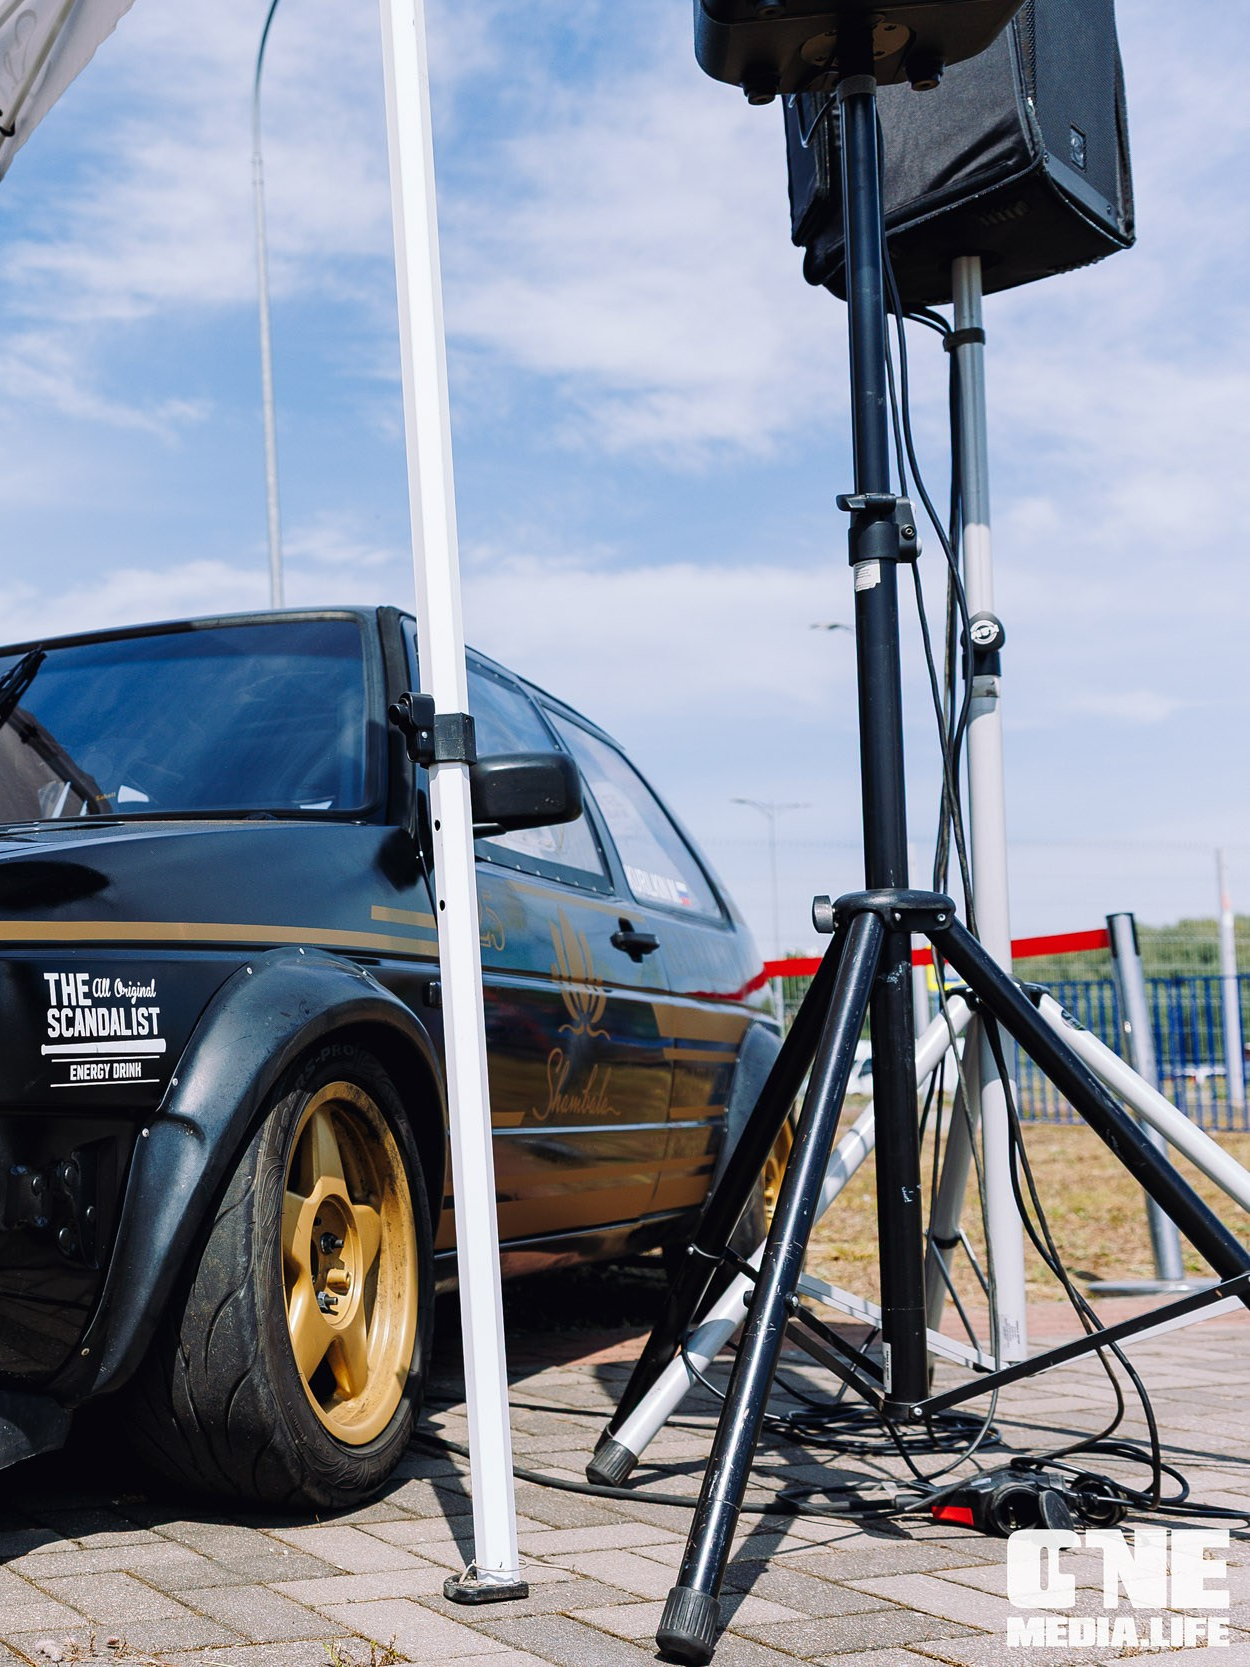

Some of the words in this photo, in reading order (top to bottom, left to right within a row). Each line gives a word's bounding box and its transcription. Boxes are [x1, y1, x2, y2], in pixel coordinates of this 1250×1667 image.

[43, 972, 93, 1006] THE
[92, 977, 111, 998] All
[114, 978, 157, 1005] Original
[46, 1007, 161, 1038] SCANDALIST
[69, 1063, 111, 1081] ENERGY
[112, 1062, 142, 1079] DRINK
[533, 1047, 622, 1121] Shambala
